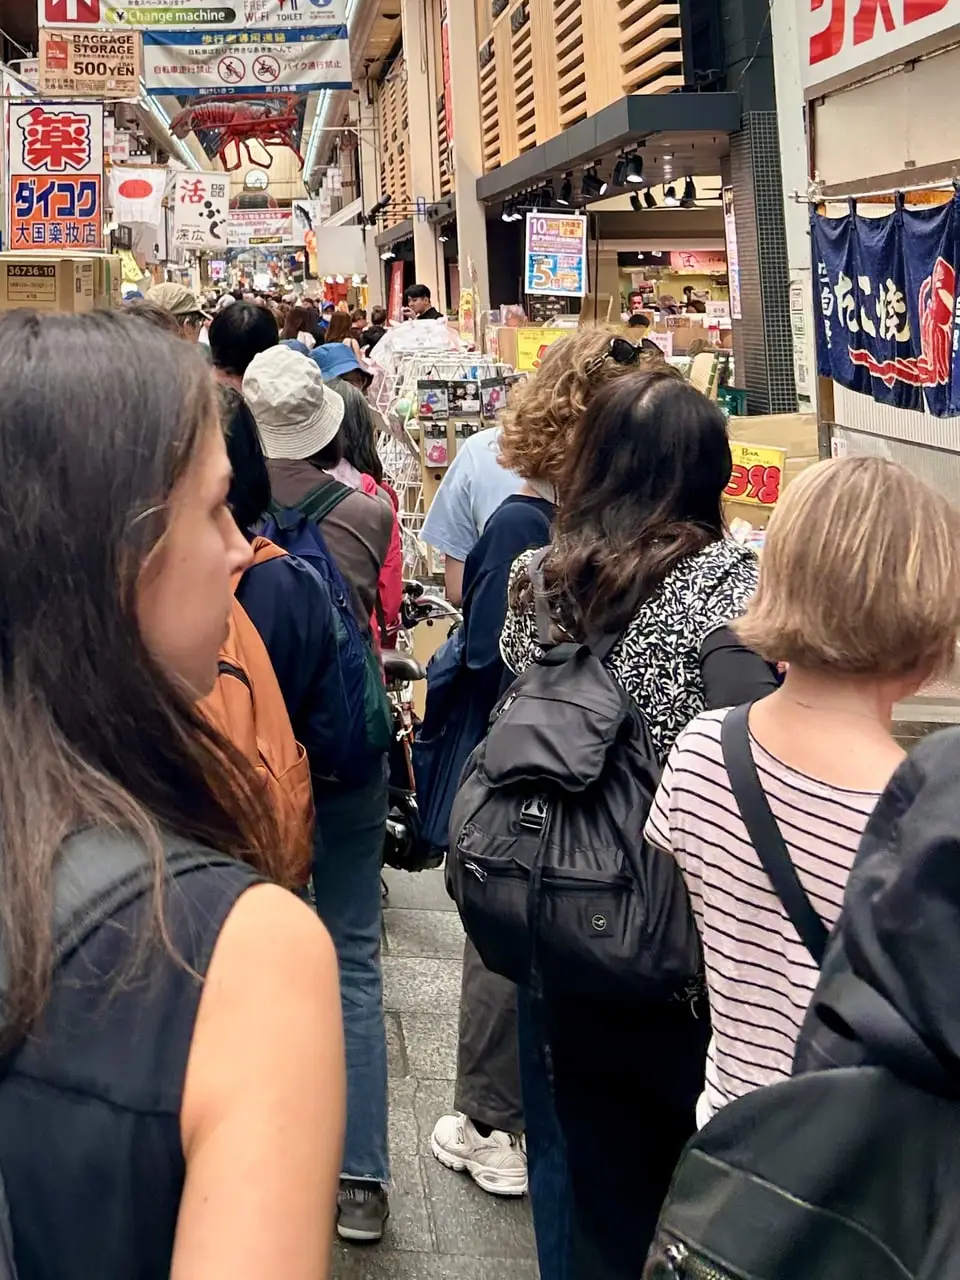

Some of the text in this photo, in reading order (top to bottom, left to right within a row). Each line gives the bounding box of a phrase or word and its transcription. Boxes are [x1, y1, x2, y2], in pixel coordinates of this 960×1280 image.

[244, 1, 268, 11] FREE
[129, 10, 177, 23] Change
[179, 9, 226, 21] machine
[276, 13, 304, 21] TOILET
[73, 34, 134, 44] BAGGAGE
[73, 44, 135, 54] STORAGE
[73, 62, 135, 76] 500 YEN
[22, 106, 90, 170] 薬
[15, 179, 97, 218] ダイコク
[179, 178, 207, 205] 活
[8, 266, 55, 276] 36736-10
[723, 464, 781, 504] 398
